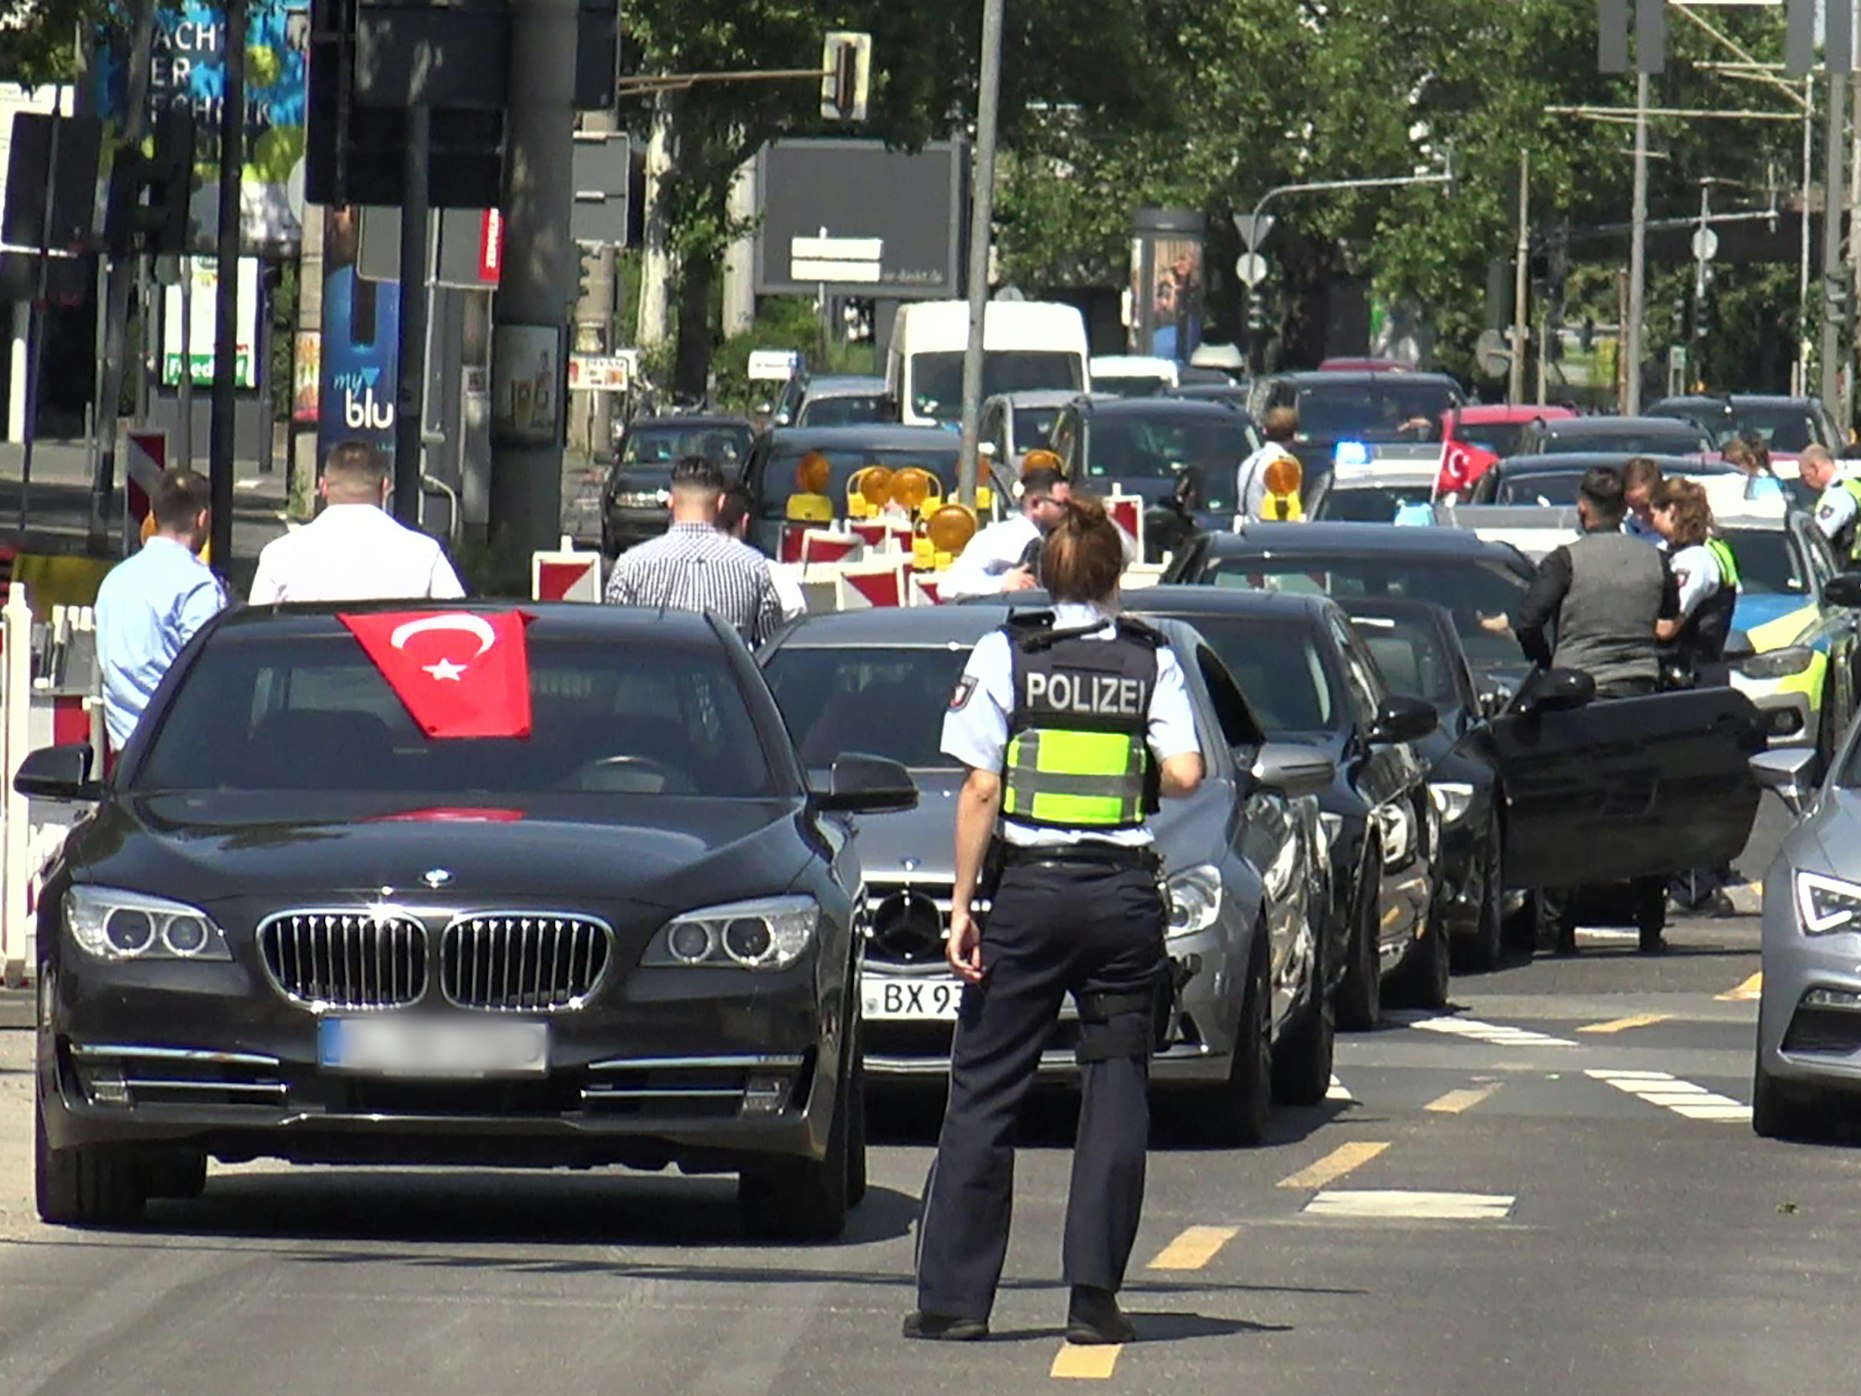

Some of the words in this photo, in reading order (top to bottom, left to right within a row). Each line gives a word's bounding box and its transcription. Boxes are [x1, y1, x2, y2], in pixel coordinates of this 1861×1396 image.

[151, 57, 191, 86] ER
[333, 373, 363, 399] my
[346, 387, 394, 429] blu
[1026, 672, 1145, 714] POLIZEI
[884, 983, 924, 1014] BX
